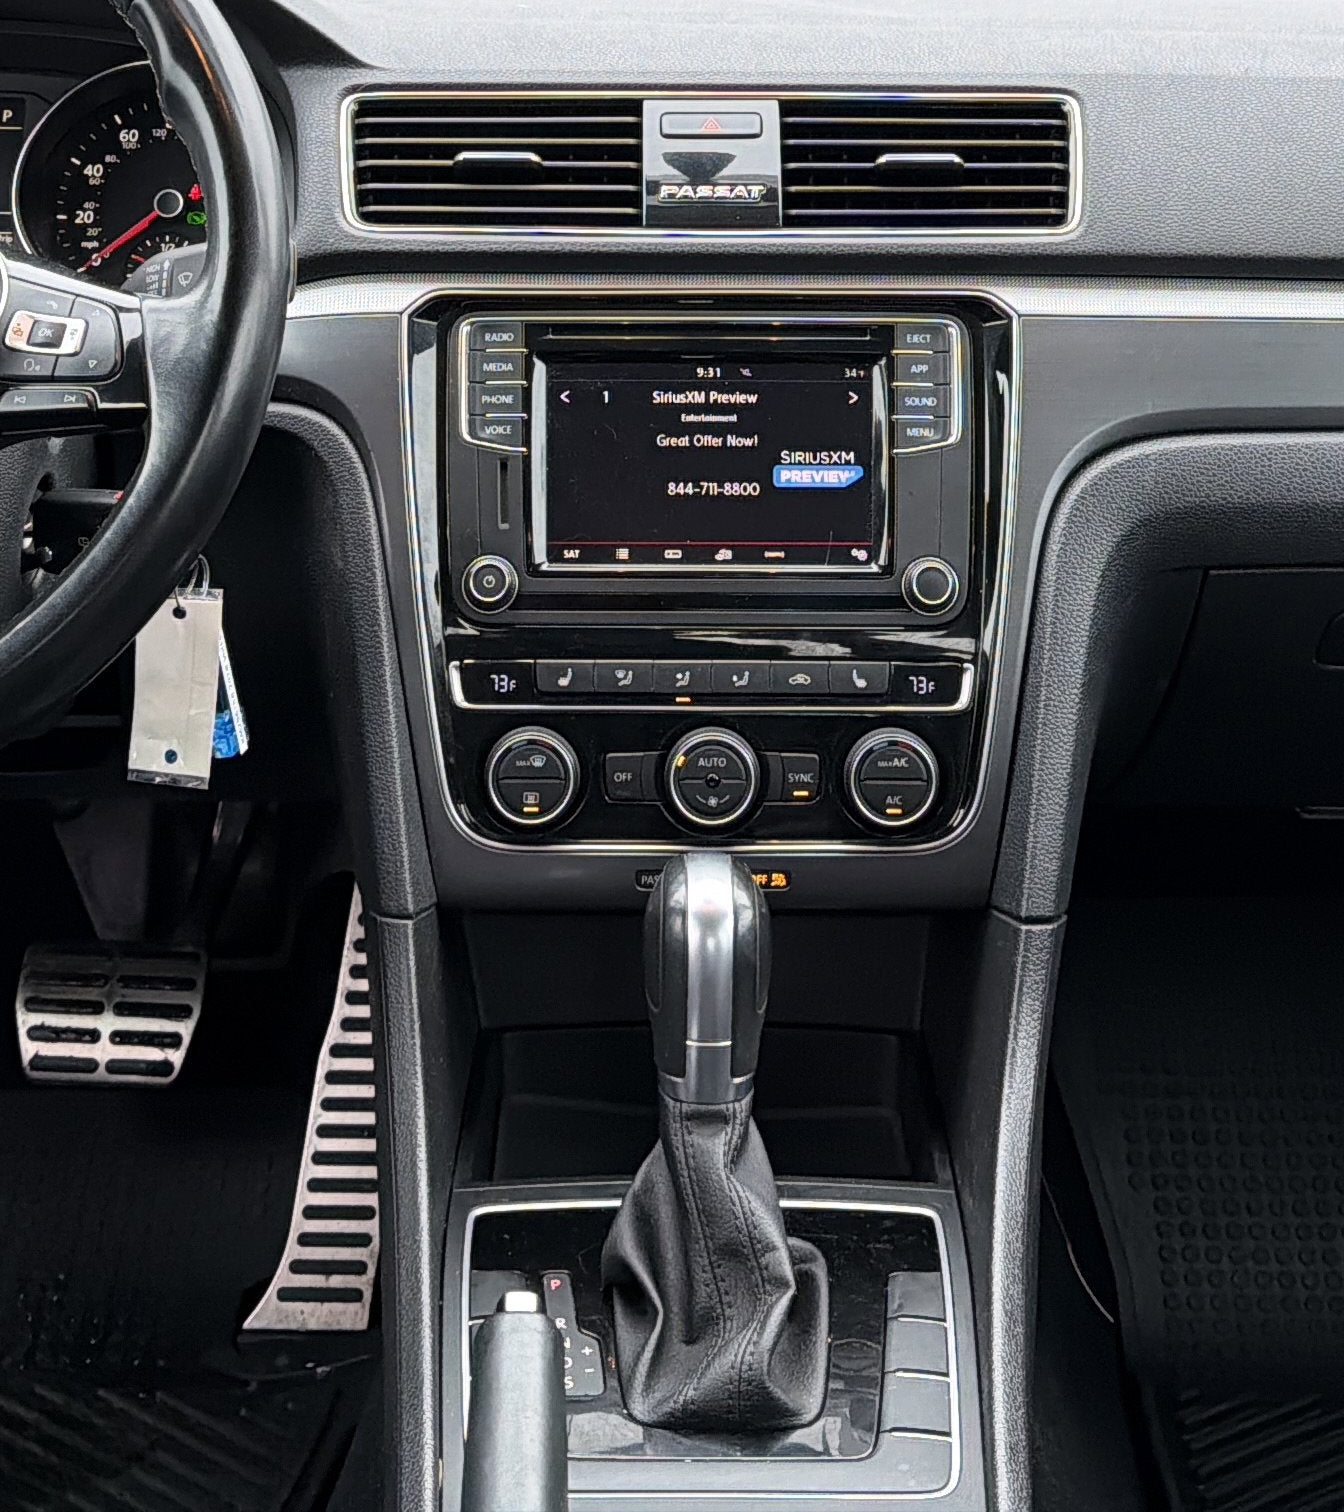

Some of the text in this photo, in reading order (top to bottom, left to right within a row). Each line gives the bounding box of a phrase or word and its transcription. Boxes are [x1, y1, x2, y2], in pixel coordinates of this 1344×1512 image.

[2, 109, 13, 123] P
[119, 129, 139, 142] 60
[83, 164, 103, 176] 40
[658, 184, 767, 201] PASSAT
[74, 211, 94, 224] 20
[485, 332, 514, 342] RADIO
[906, 334, 931, 343] EJECT
[483, 362, 514, 372] MEDIA
[696, 367, 721, 378] 9:31
[910, 364, 928, 373] APP
[481, 395, 514, 405] PHONE
[652, 390, 758, 405] SiriusXM Preview
[905, 397, 937, 407] SOUND
[680, 413, 737, 423] Entertainment
[484, 425, 512, 435] VOICE
[906, 428, 934, 437] MENU
[656, 434, 758, 447] Great Offer Now!
[780, 450, 855, 465] SIRIUSXM
[667, 482, 760, 496] 844-711-8800
[563, 549, 580, 559] SAT
[697, 757, 727, 768] AUTO
[613, 772, 633, 783] OFF
[788, 773, 815, 784] SYNC
[885, 795, 903, 805] A/C
[550, 1279, 561, 1290] P
[555, 1317, 567, 1329] R
